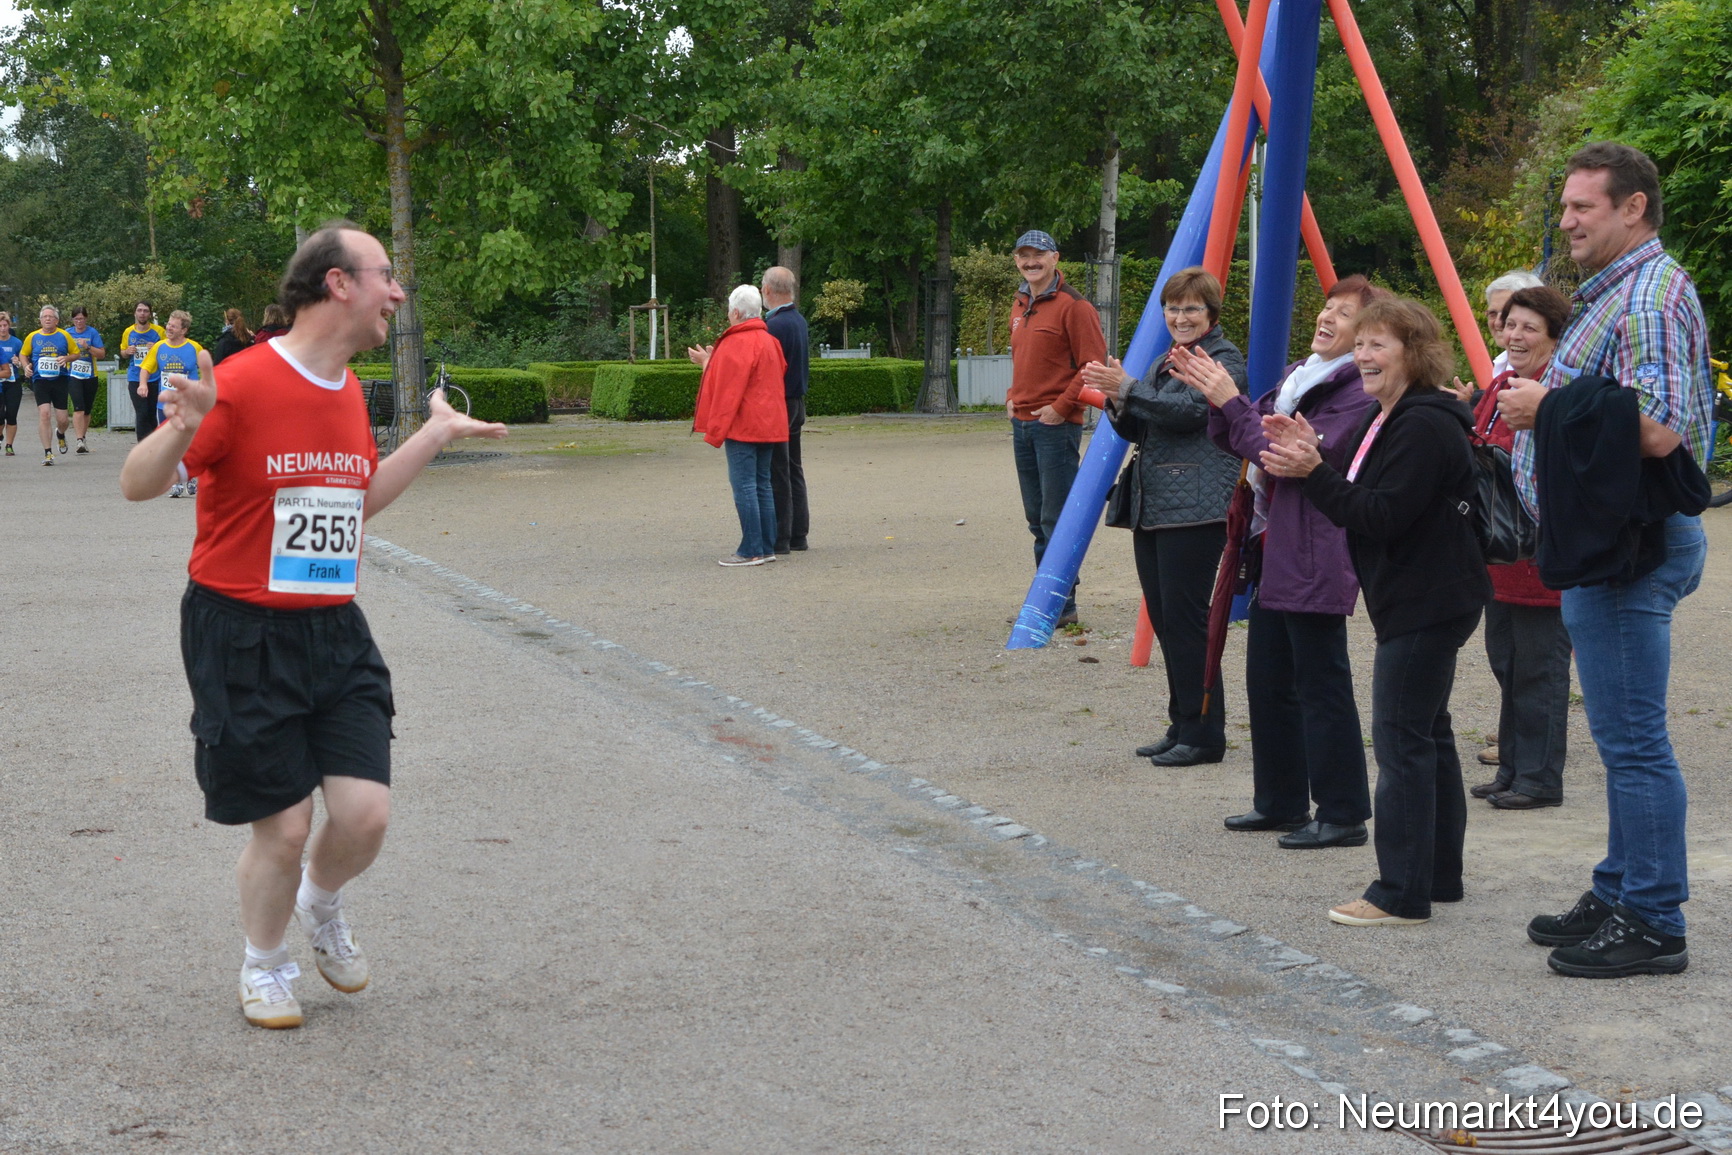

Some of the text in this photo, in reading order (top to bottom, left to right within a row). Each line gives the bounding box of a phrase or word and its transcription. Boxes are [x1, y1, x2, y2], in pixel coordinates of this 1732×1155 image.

[40, 361, 59, 370] 2616
[73, 363, 90, 373] 2287
[267, 452, 362, 474] NEUMARKT
[278, 497, 355, 509] PARTL Neumarkt
[285, 513, 357, 553] 2553
[308, 563, 341, 579] Frank
